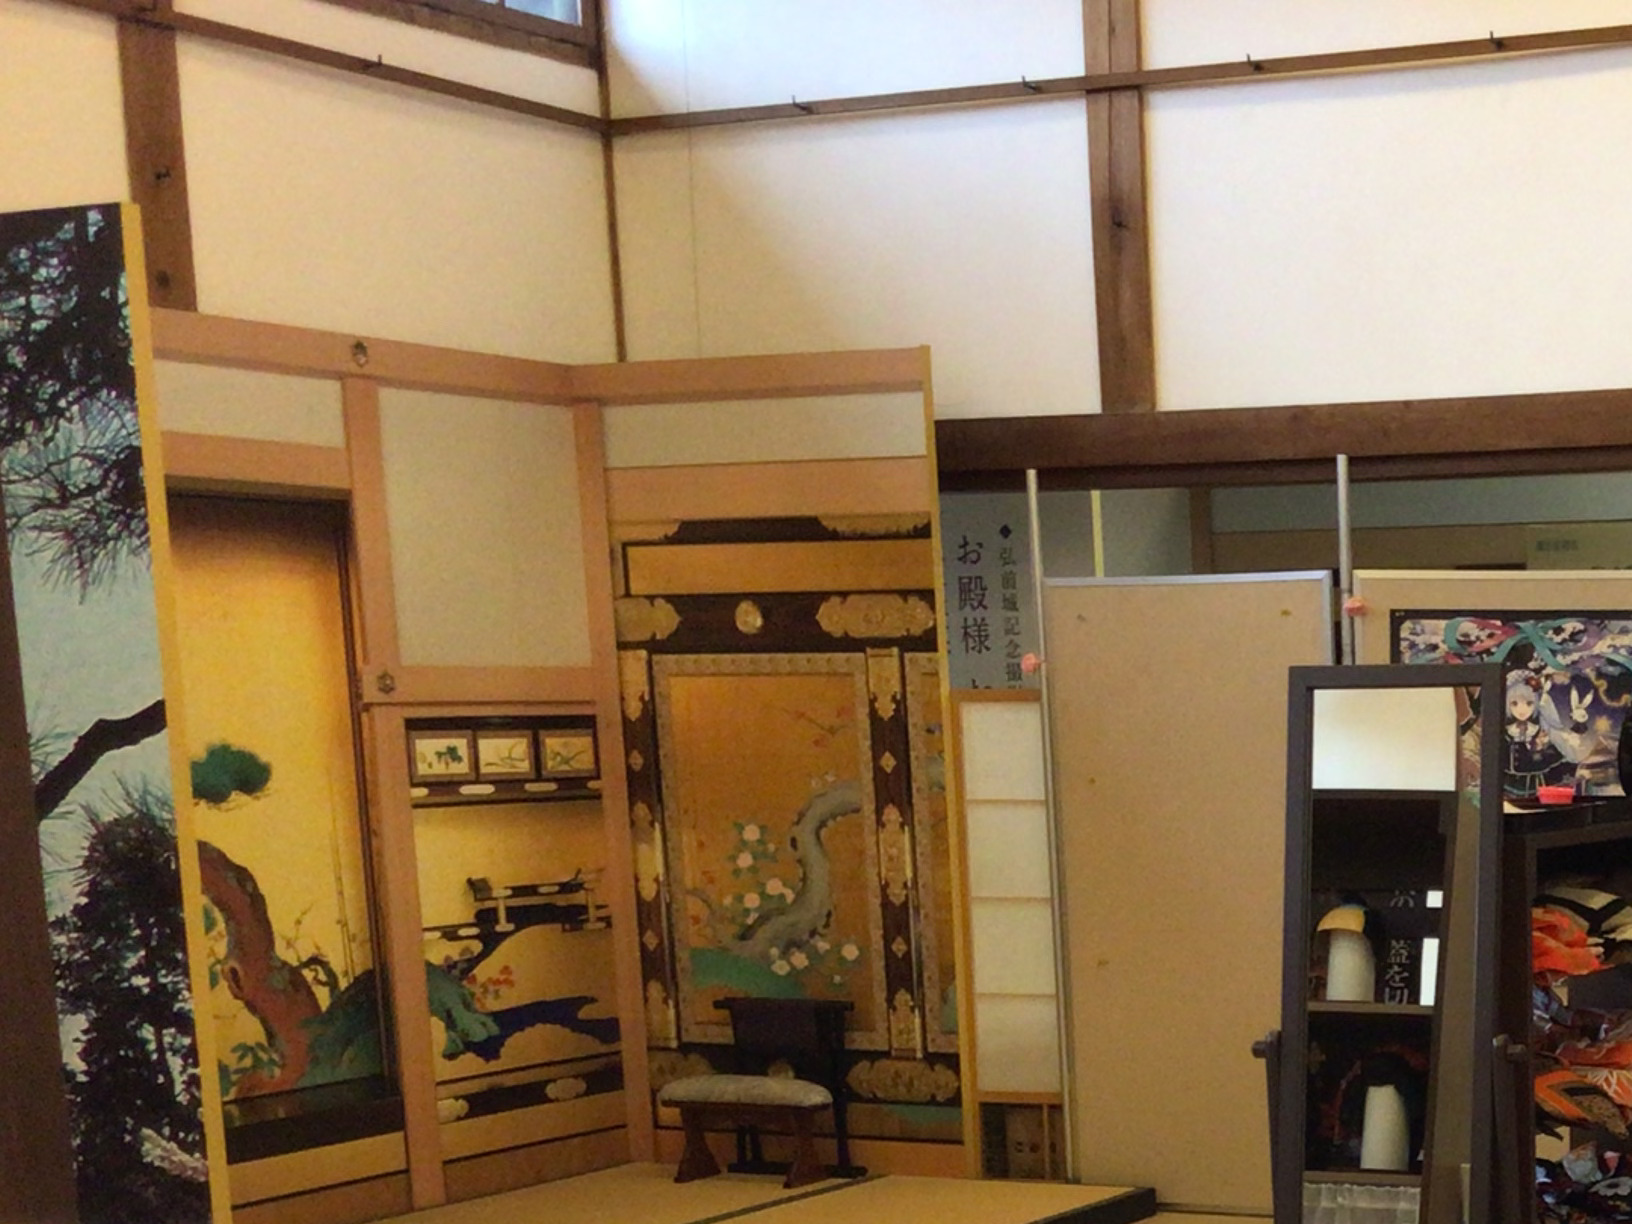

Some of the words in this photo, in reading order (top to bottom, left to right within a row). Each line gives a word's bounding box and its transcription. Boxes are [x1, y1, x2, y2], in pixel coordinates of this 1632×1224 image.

[956, 534, 991, 655] お殿様
[999, 547, 1024, 689] 弘前城記念撮
